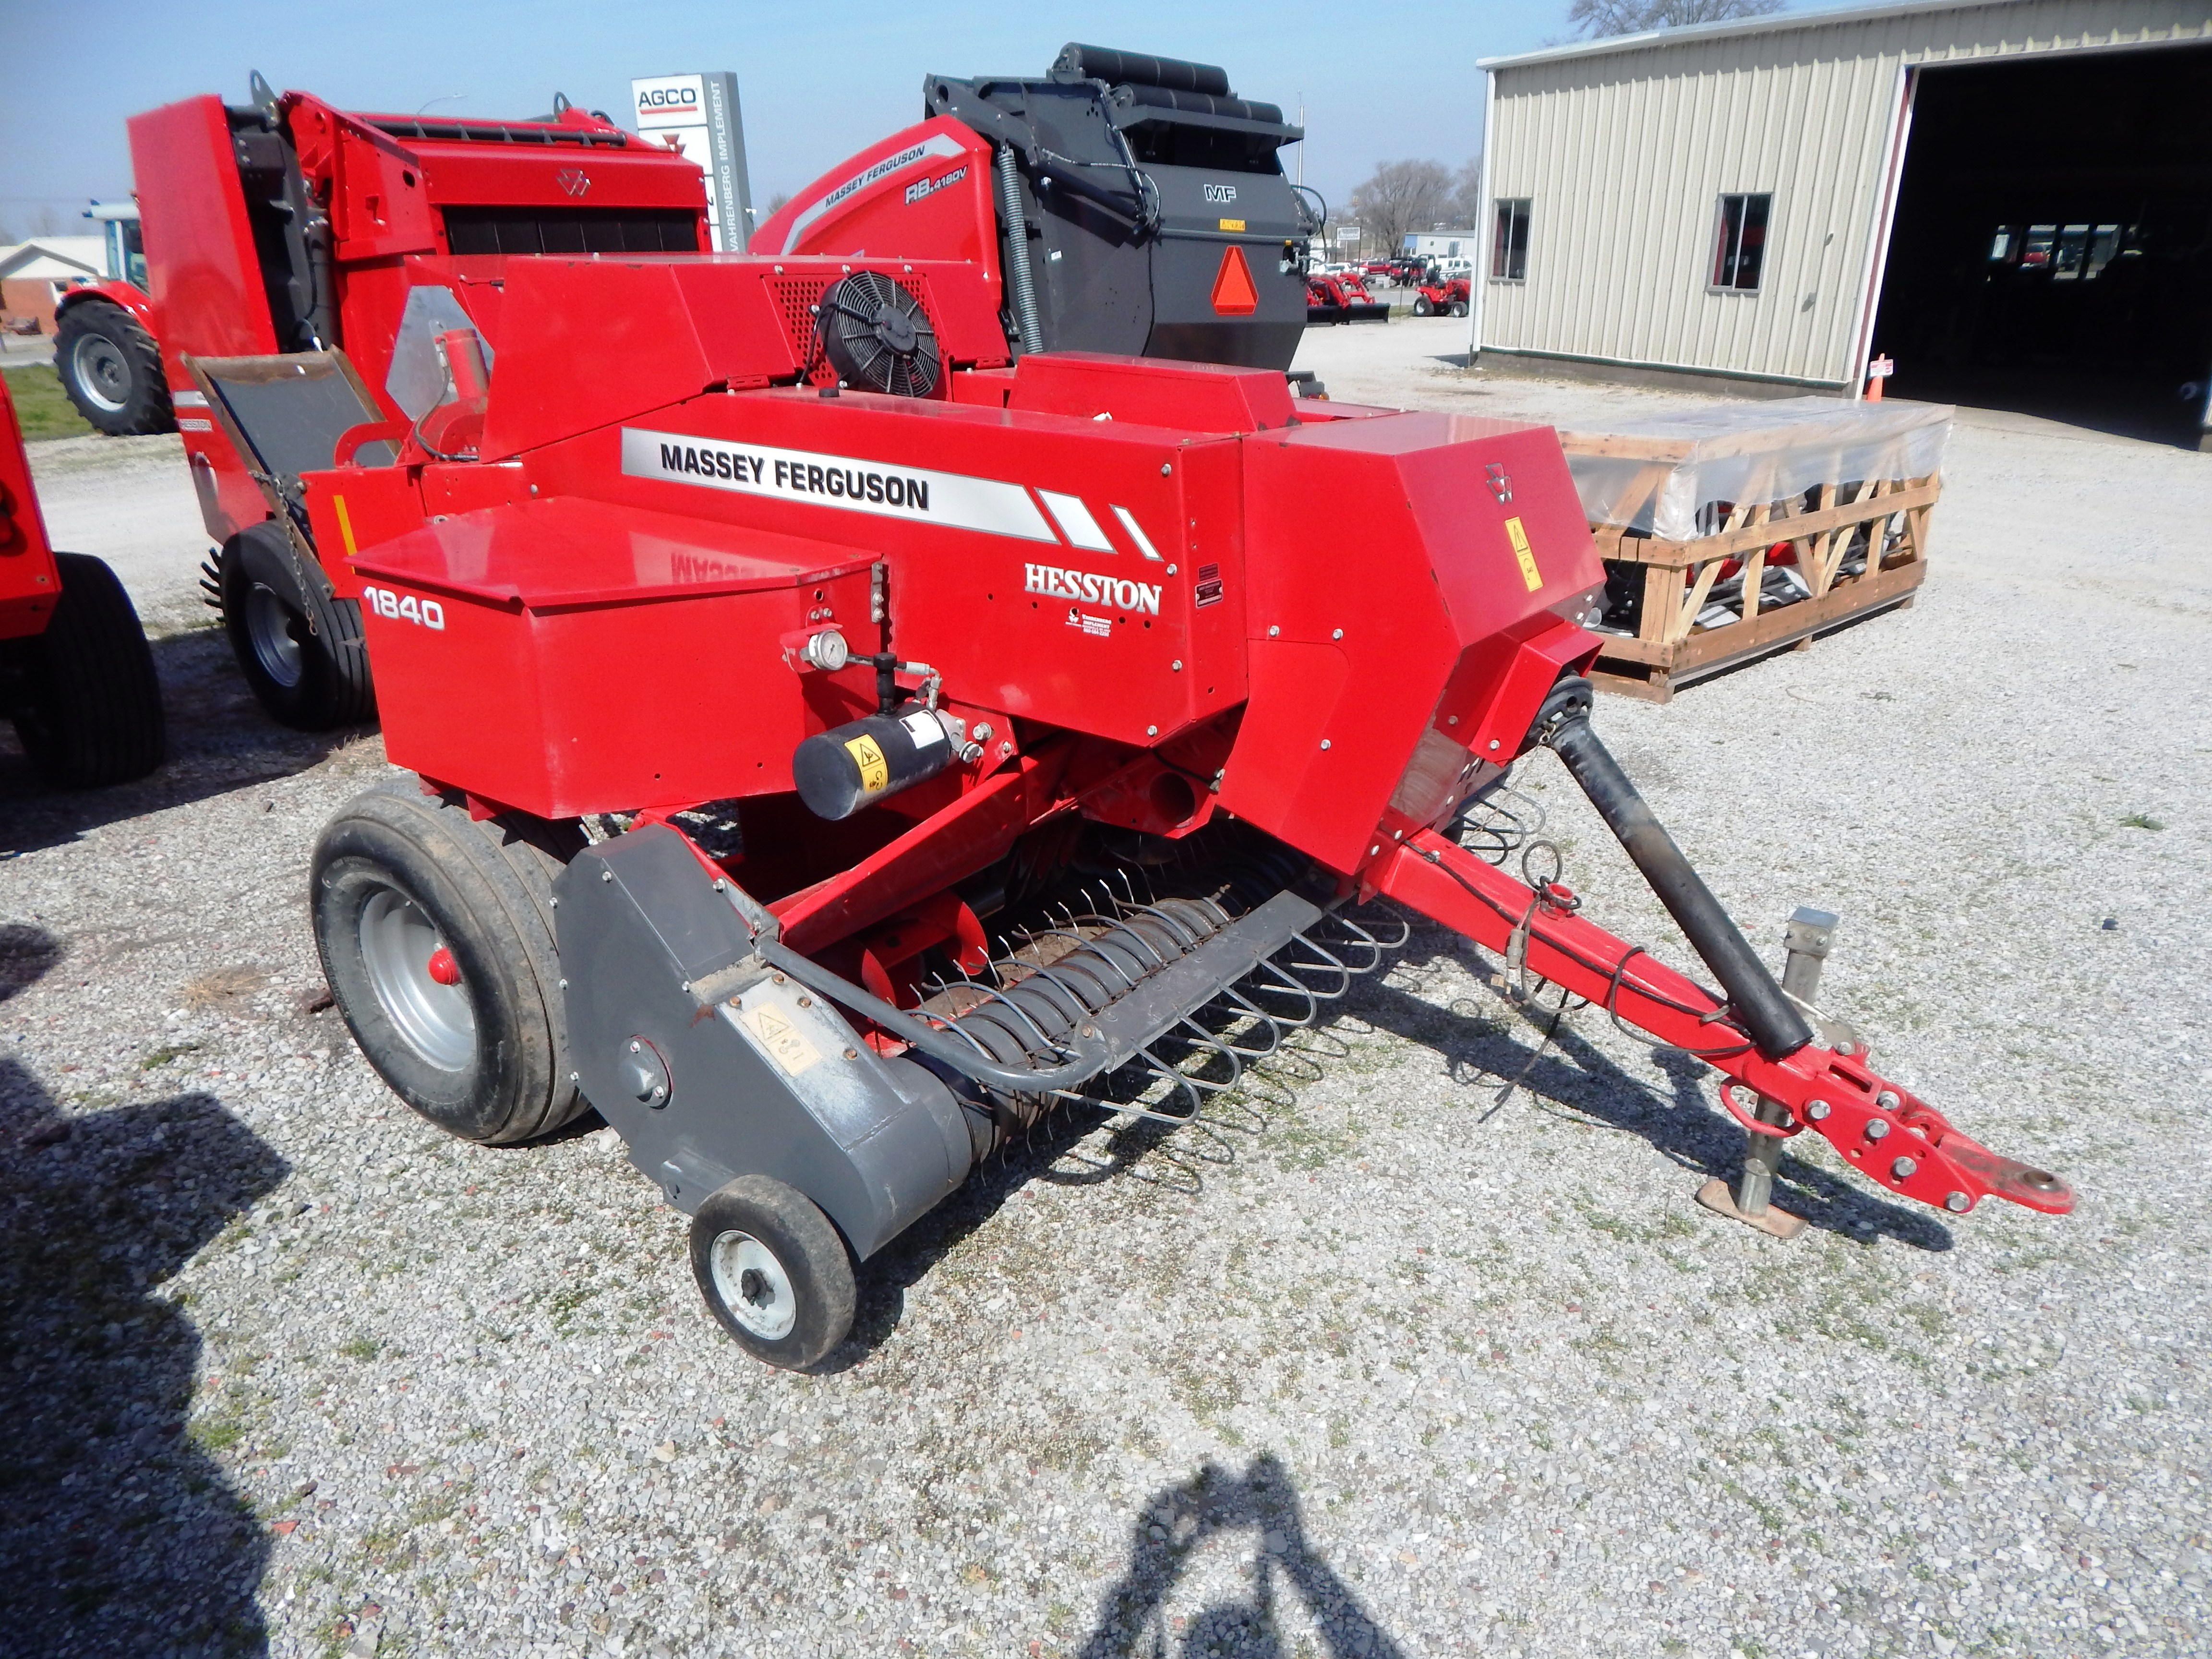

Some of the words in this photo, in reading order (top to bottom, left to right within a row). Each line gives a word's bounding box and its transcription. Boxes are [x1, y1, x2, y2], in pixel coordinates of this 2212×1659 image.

[638, 87, 697, 108] AGCO
[711, 81, 728, 160] IMPLEMENT
[825, 175, 864, 208] MASSEY
[866, 145, 926, 182] FERGUSON
[1203, 184, 1237, 202] MF
[721, 165, 739, 252] VAHRENBERG
[660, 443, 763, 484] MASSEY
[774, 460, 929, 510] FERGUSON
[363, 586, 445, 631] 1840
[1024, 563, 1163, 616] HESSTON
